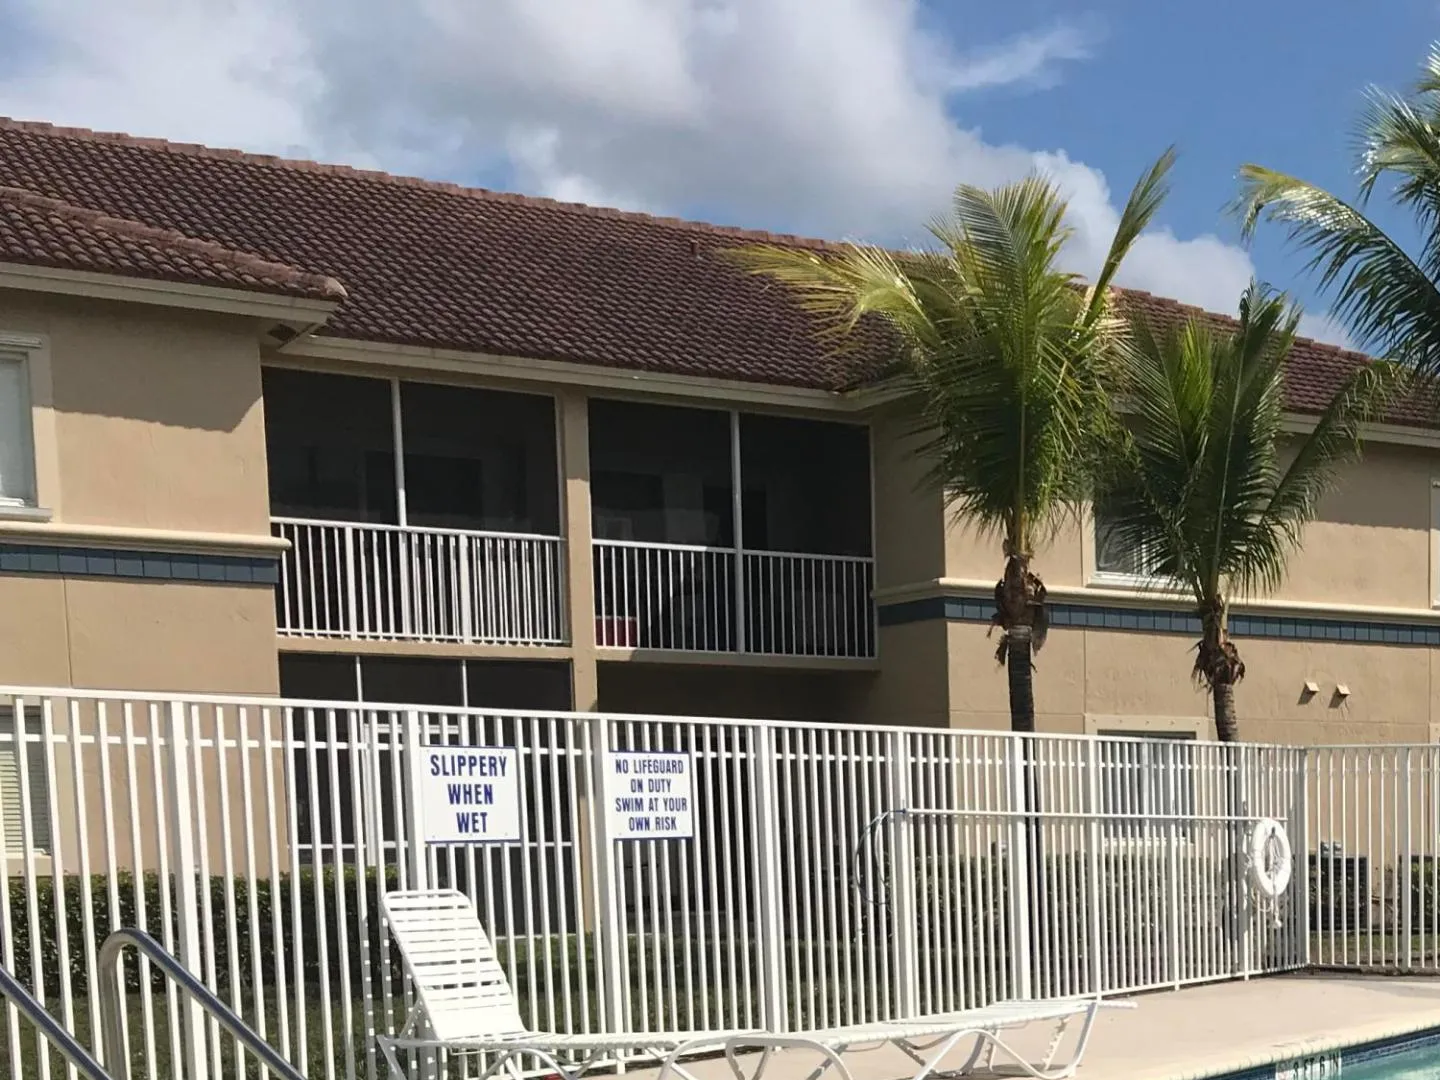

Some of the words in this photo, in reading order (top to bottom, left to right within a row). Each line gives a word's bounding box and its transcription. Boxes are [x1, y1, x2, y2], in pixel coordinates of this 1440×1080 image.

[430, 754, 507, 777] SLIPPERY
[615, 759, 629, 774] NO
[633, 759, 684, 774] LIFEGUARD
[630, 778, 643, 793] ON
[648, 778, 672, 793] DUTY
[447, 783, 494, 805] WHEN
[615, 797, 644, 812] SWIM
[648, 797, 659, 812] AT
[663, 797, 688, 812] YOUR
[456, 812, 488, 833] WET
[628, 816, 650, 832] OWN
[655, 816, 677, 831] RISK
